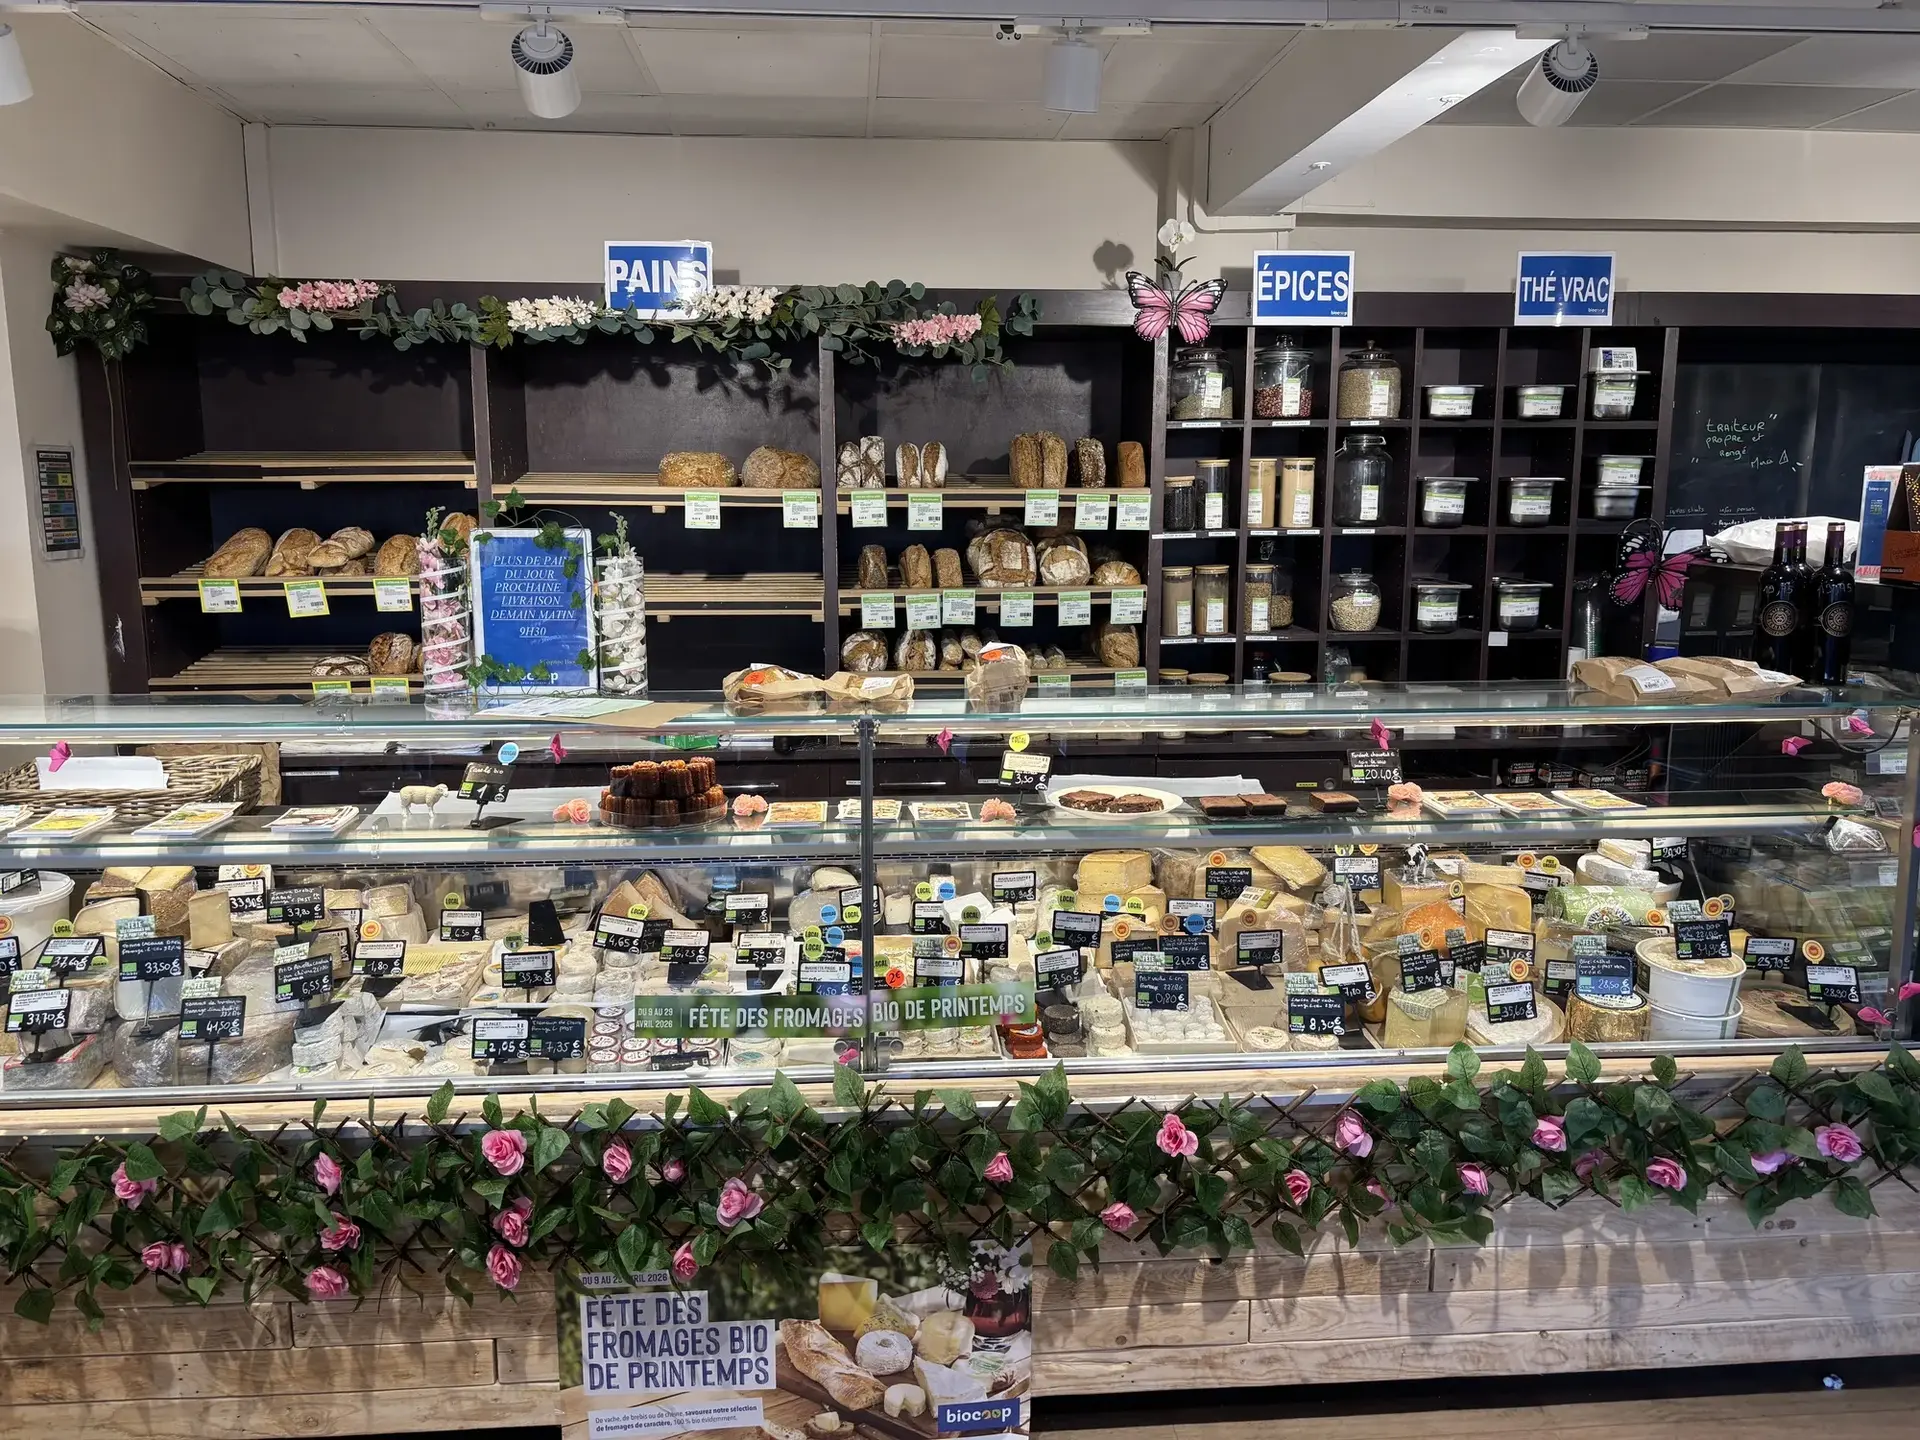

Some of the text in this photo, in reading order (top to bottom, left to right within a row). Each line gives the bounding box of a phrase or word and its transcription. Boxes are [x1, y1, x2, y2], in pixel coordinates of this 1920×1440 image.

[609, 259, 707, 293] PAINS
[1258, 263, 1349, 302] ÉPICES
[1521, 270, 1609, 303] THÉ VRAC
[493, 556, 522, 566] PLUS
[525, 556, 540, 566] DE
[505, 569, 554, 579] DU JOUR
[495, 582, 561, 592] PROCHAINE
[501, 595, 561, 605] LIVRAISON
[491, 609, 575, 619] DEMAIN MATIN
[520, 626, 546, 636] 9H30
[1060, 896, 1074, 904] LOCAL
[631, 908, 646, 916] LOCAL
[54, 925, 71, 933] LOCAL
[805, 943, 822, 951] LOCAL
[638, 1007, 673, 1016] DU 9 AU 29
[689, 994, 1025, 1028] FÊTE DES FROMAGES BIO DE PRINTEMPS
[636, 1020, 673, 1028] AVRIL 2026
[582, 1276, 593, 1285] DU
[594, 1276, 599, 1284] 9
[601, 1276, 611, 1284] AU
[648, 1273, 667, 1283] 2026
[586, 1295, 701, 1328] FÊTE DES
[587, 1325, 768, 1360] FROMAGES BIO
[589, 1357, 769, 1391] DE PRINTEMPS
[946, 1407, 1011, 1422] biocoop
[605, 1423, 634, 1432] fromages
